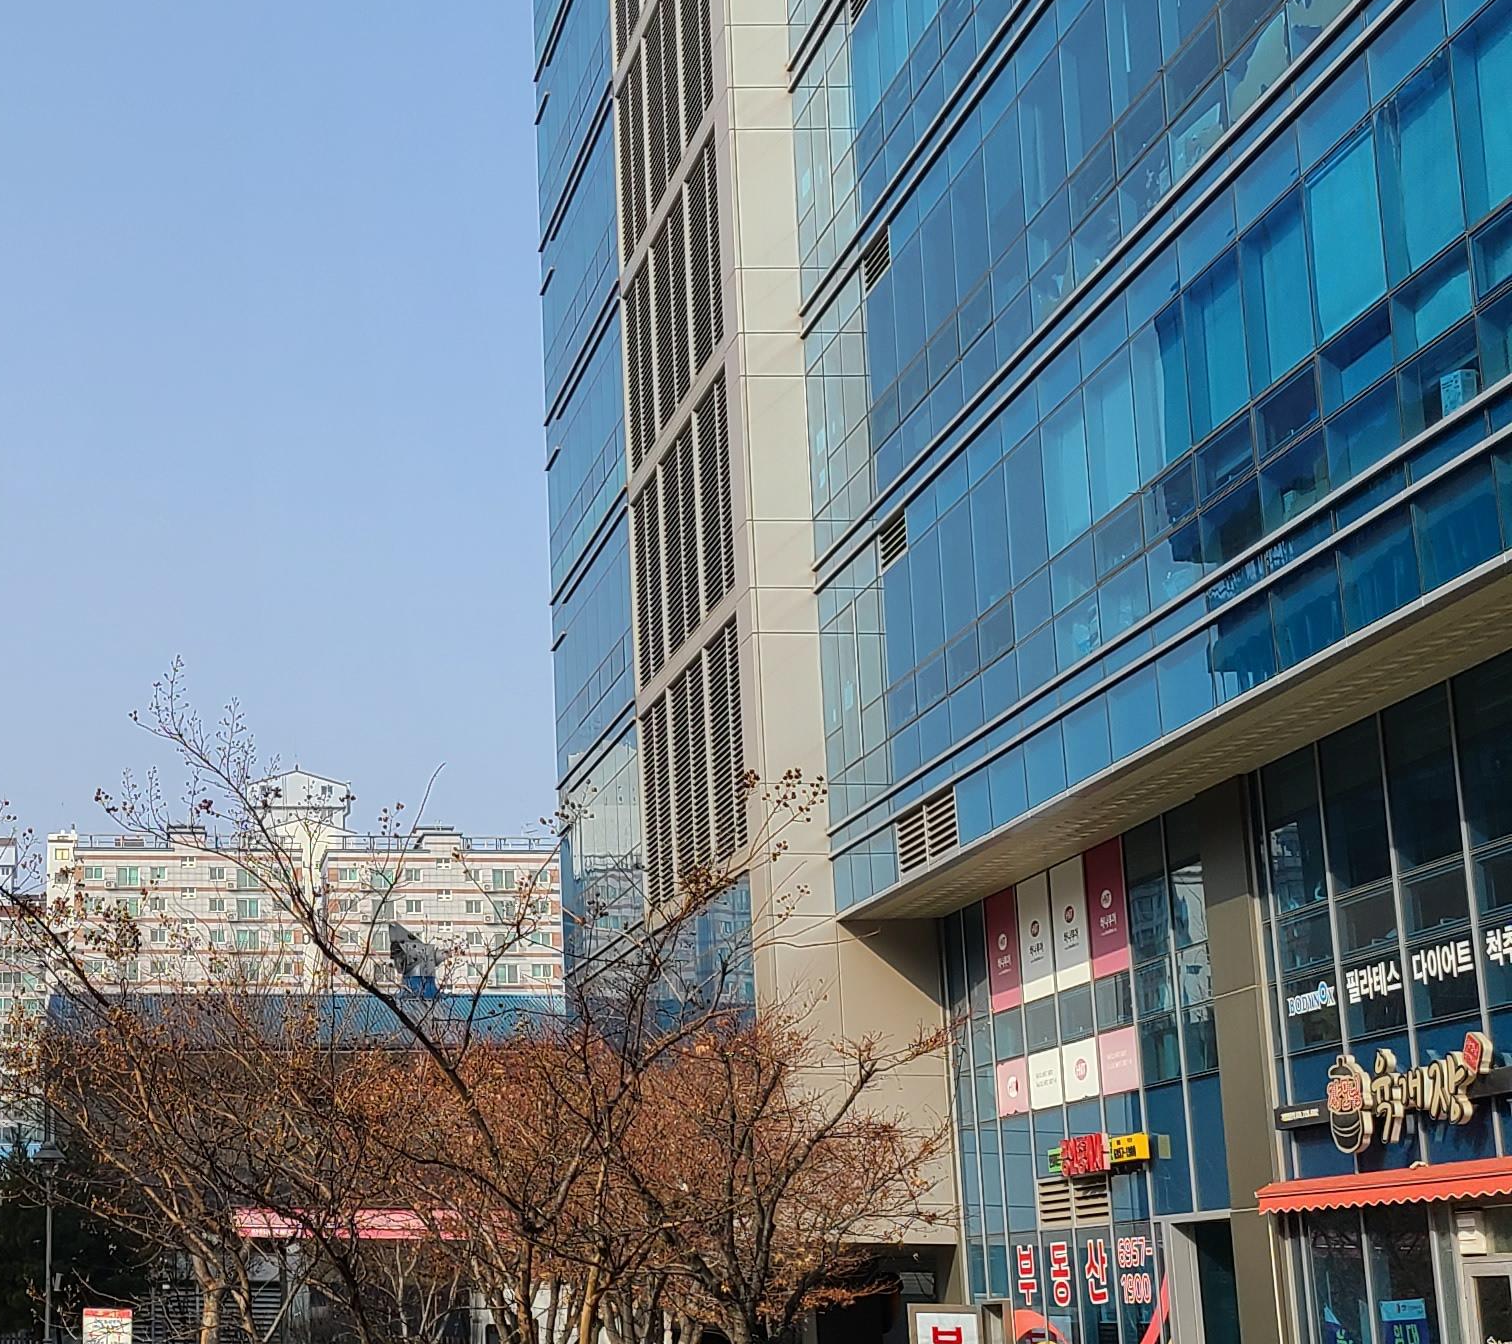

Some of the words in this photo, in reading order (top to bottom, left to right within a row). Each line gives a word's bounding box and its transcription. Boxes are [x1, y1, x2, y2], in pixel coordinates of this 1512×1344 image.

[1346, 961, 1402, 1004] 필라테스
[1412, 941, 1474, 985] 다이어트
[1371, 1048, 1470, 1144] 육개장
[1016, 1239, 1110, 1306] 부동산
